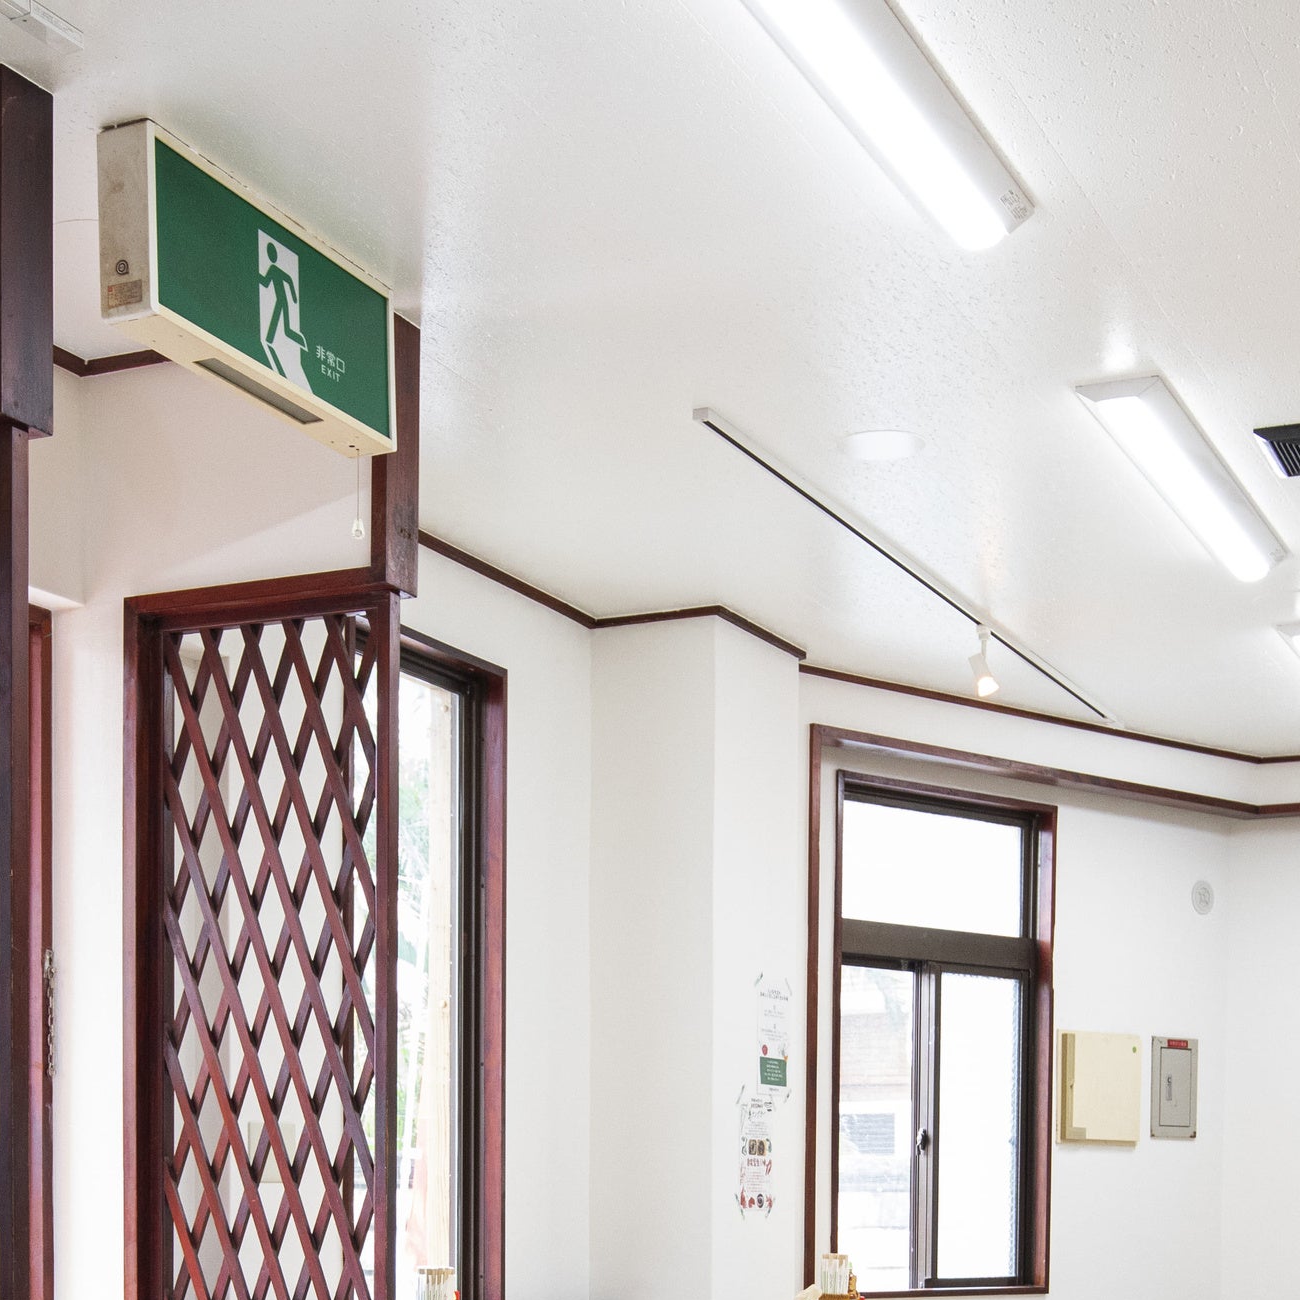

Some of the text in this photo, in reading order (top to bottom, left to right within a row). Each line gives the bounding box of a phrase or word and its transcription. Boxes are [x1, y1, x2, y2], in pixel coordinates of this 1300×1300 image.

[316, 345, 345, 374] 非常口
[321, 364, 340, 382] EXIT
